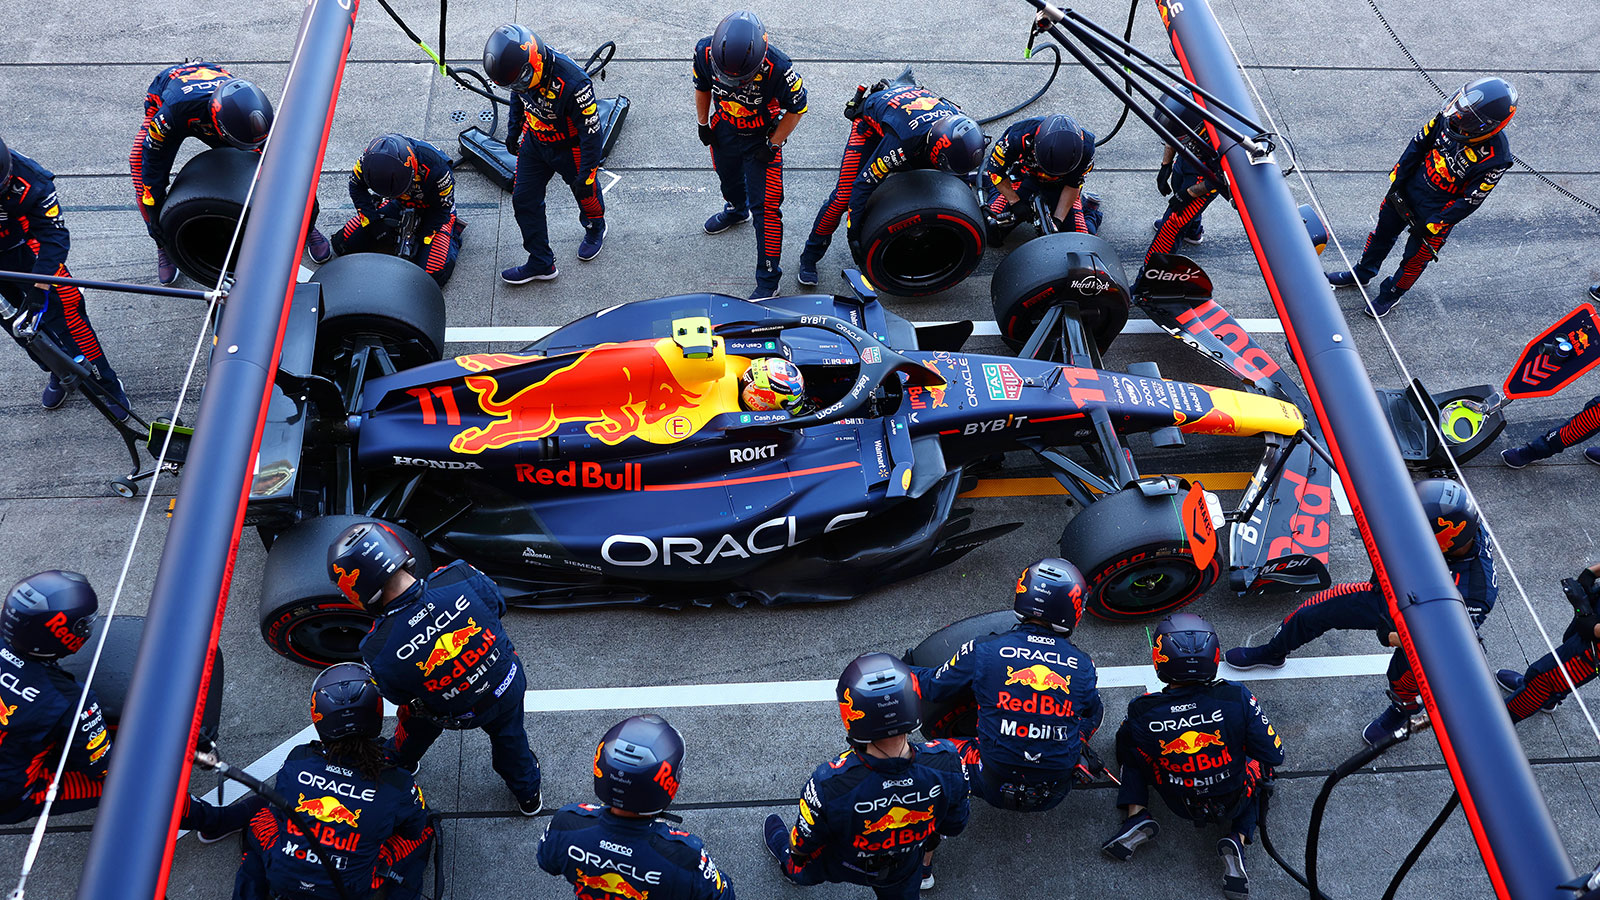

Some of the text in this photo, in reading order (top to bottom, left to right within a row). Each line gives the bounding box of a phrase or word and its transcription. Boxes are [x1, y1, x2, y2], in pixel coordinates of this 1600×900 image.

[712, 85, 763, 105] ORACLE
[887, 91, 916, 109] Bull
[737, 115, 764, 129] Bull
[1431, 173, 1458, 194] Bull
[1071, 280, 1091, 289] Hard
[1145, 269, 1190, 281] Claro
[801, 316, 827, 325] BYBIT
[836, 323, 862, 342] ORACLE
[1176, 299, 1281, 382] Bull
[851, 374, 870, 399] telcel
[959, 358, 978, 407] ORACLE
[987, 366, 1001, 397] TAG
[1001, 365, 1020, 398] HEUER
[1063, 367, 1106, 409] 11
[1140, 379, 1155, 407] zoom
[405, 386, 461, 425] 11
[816, 401, 844, 419] zoom
[908, 386, 927, 409] Bull
[1189, 391, 1203, 412] Mobil
[964, 414, 1027, 435] BYBIT
[393, 456, 483, 470] HONDA
[729, 444, 778, 463] ROKT
[874, 440, 886, 469] Walmart
[515, 461, 642, 491] Red Bull
[1197, 496, 1212, 536] BRAKES
[1267, 468, 1331, 564] Red
[563, 559, 602, 571] SIEMENS
[1093, 552, 1146, 584] ZERO
[1260, 557, 1312, 575] Mobil
[396, 594, 470, 660] ORACLE
[408, 602, 436, 628] sparco
[268, 612, 292, 645] ZERO
[1027, 634, 1056, 646] sparco
[424, 628, 496, 692] Red Bull
[999, 646, 1078, 670] ORACLE
[0, 672, 40, 702] CLE
[442, 663, 488, 700] Mobil
[494, 662, 517, 698] sparco
[80, 702, 99, 720] Mobil
[996, 691, 1074, 717] Red Bull
[1170, 702, 1197, 713] sparco
[81, 714, 102, 732] Claro
[1000, 718, 1051, 740] Mobil
[1149, 709, 1224, 732] ORACLE
[1158, 745, 1232, 773] Red Bull
[297, 771, 376, 801] ORACLE
[882, 778, 913, 789] sparco
[1168, 773, 1213, 787] Mobil
[854, 784, 941, 813] ORACLE
[320, 823, 361, 852] Bull
[853, 818, 936, 851] Red Bull
[599, 839, 633, 857] sparco
[567, 845, 662, 885] ORACLE
